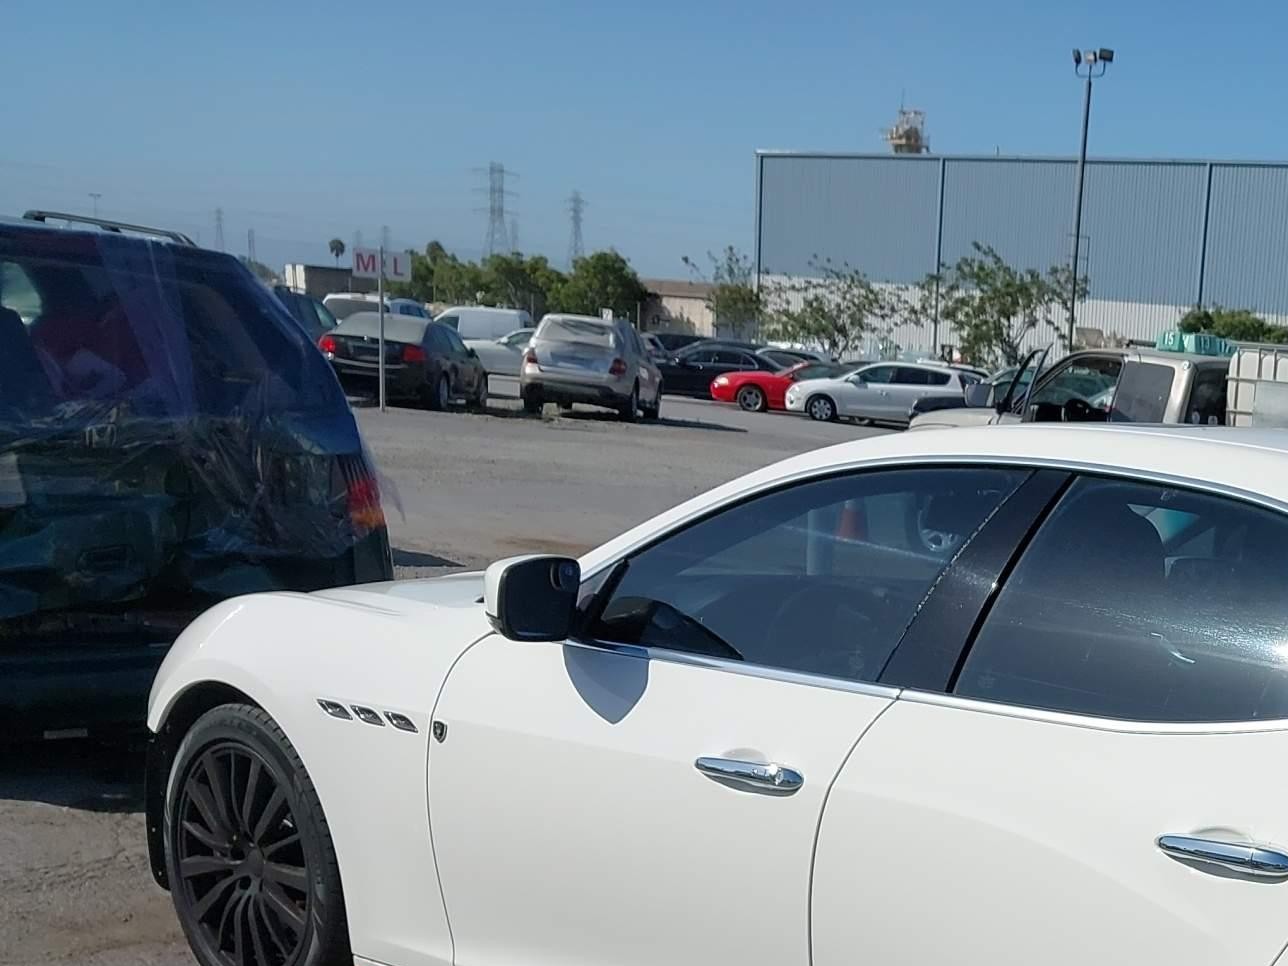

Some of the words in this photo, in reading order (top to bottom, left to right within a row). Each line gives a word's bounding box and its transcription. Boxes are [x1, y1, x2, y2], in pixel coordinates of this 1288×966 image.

[356, 252, 376, 272] M
[393, 256, 404, 276] L
[1163, 331, 1175, 346] 15
